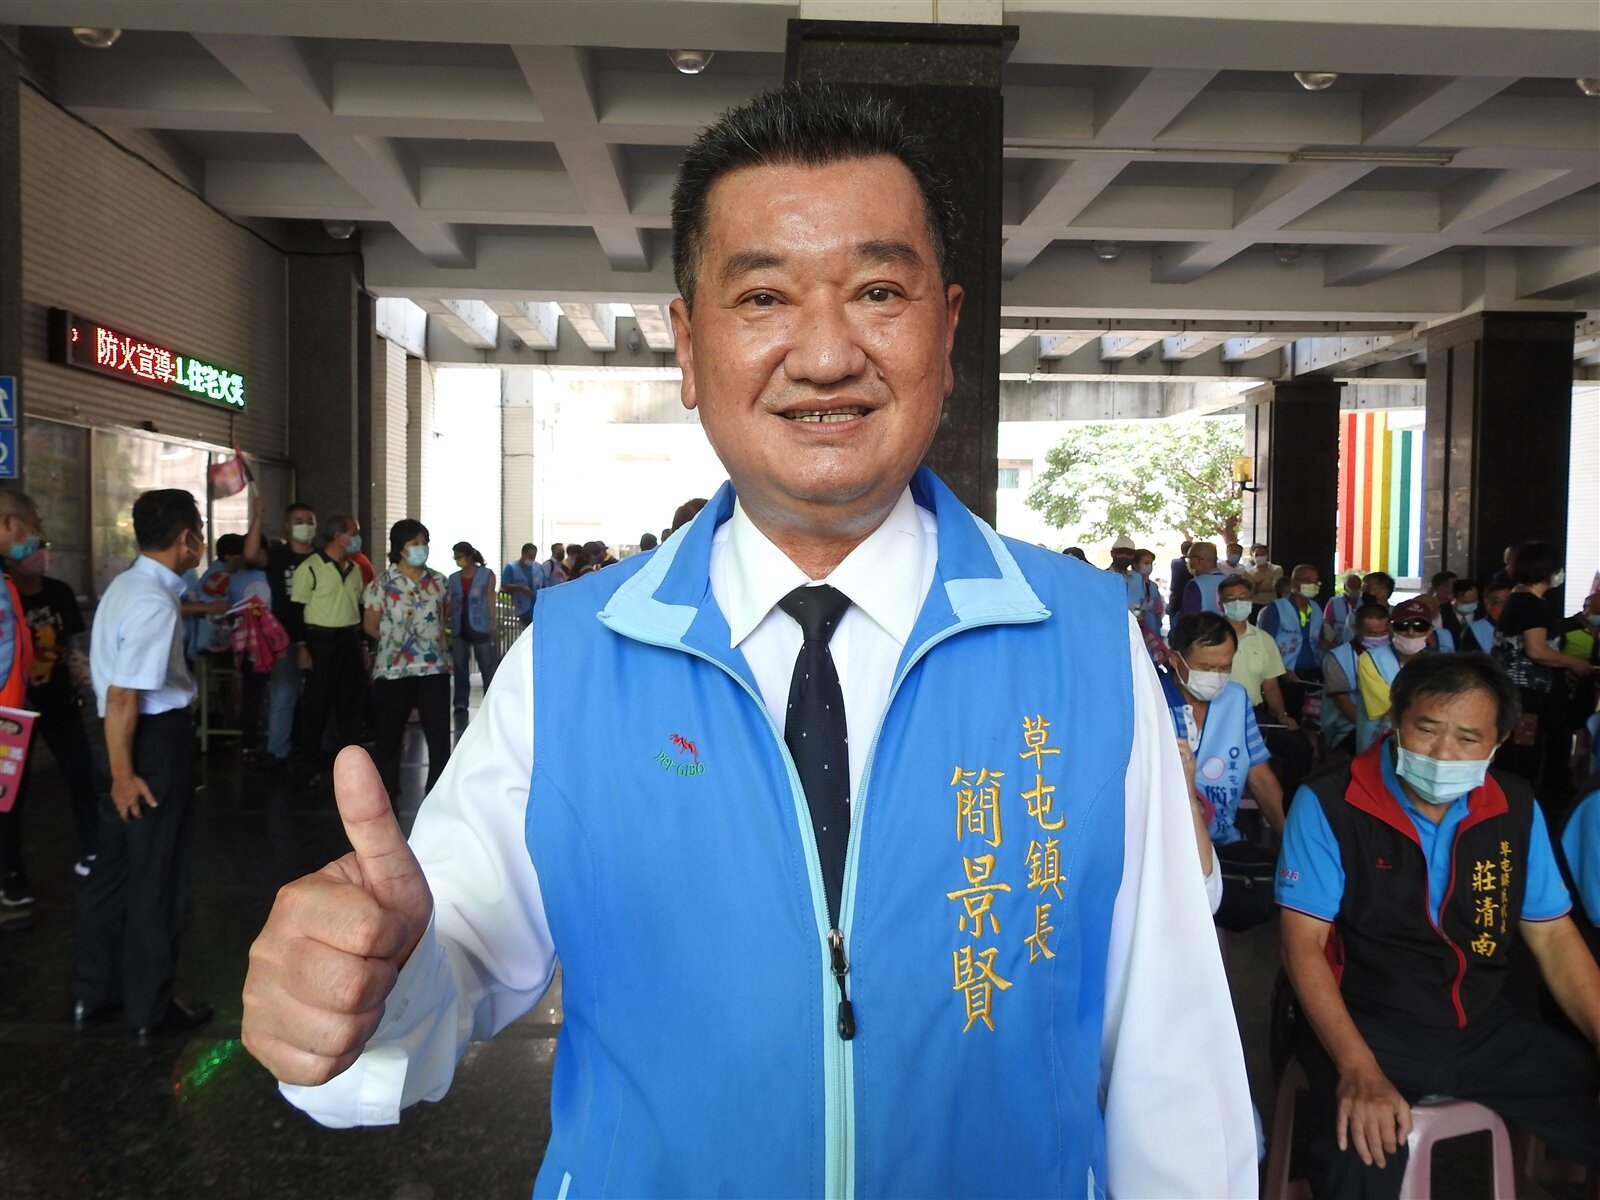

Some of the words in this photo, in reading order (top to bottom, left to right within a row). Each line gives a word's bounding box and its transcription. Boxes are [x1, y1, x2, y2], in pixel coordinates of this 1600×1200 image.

[946, 766, 1013, 1033] 簡景賢
[1020, 715, 1066, 963] 草屯鎮長
[1471, 860, 1498, 957] 莊清南
